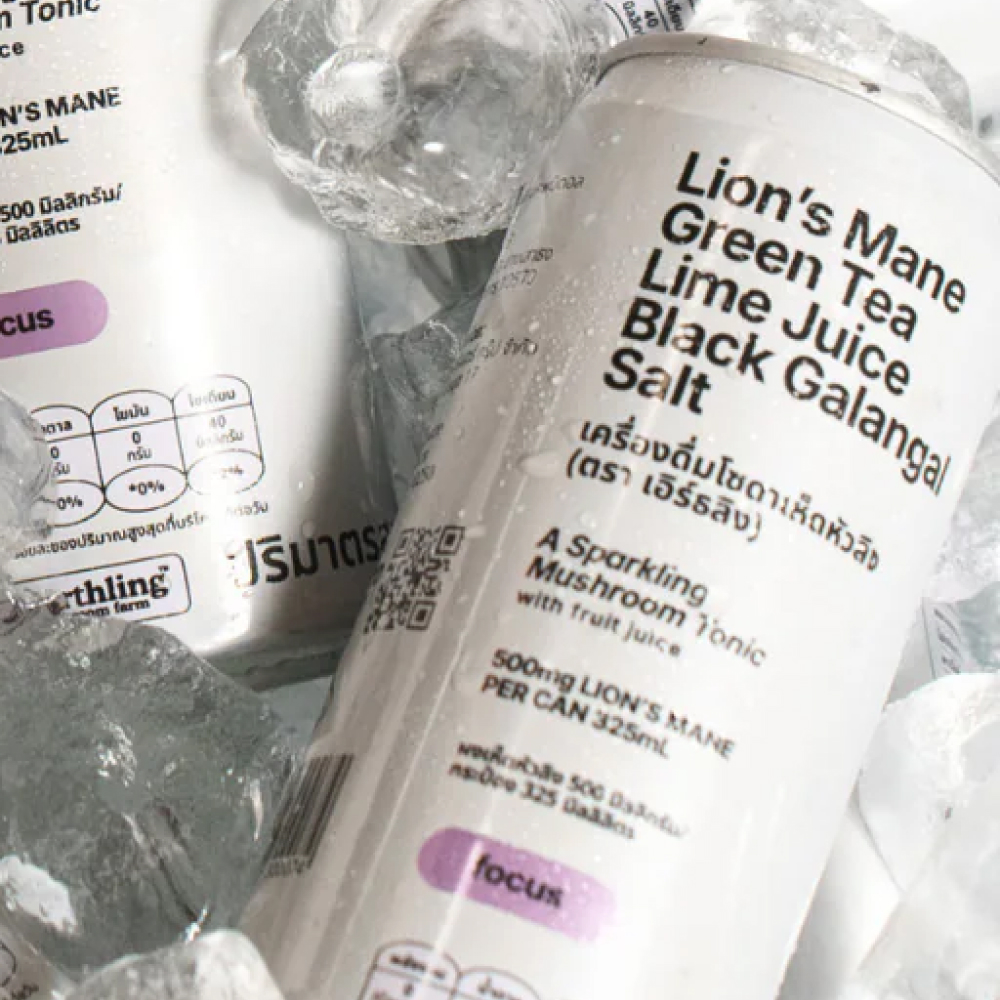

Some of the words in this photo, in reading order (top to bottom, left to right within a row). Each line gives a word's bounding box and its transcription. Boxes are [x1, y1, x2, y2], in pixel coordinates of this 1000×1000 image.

[45, 86, 123, 119] MANE
[0, 199, 34, 224] 500
[676, 151, 834, 237] Lion's
[842, 209, 967, 314] Mane
[661, 201, 823, 290] Green
[840, 259, 918, 342] Tea
[639, 248, 773, 324] Lime
[782, 302, 912, 396] Juice
[603, 346, 712, 415] Salt
[620, 298, 773, 383] Black
[784, 355, 952, 496] Galangal
[56, 496, 83, 510] 0%
[565, 446, 632, 487] (ตรา
[579, 416, 880, 573] เครื่องดื่มโซดาเห็ดหัวลิง
[535, 527, 561, 551] A
[565, 533, 709, 608] Sparkling
[114, 599, 150, 614] farm
[516, 588, 563, 616] with
[569, 599, 621, 634] fruit
[622, 617, 682, 659] juice
[525, 556, 687, 628] Mushroom
[697, 611, 768, 668] Tonic
[481, 675, 529, 704] PER
[533, 688, 588, 725] CAN
[592, 709, 671, 760] 325mL
[491, 648, 576, 692] 500mg
[578, 675, 661, 724] LION'S
[665, 710, 737, 761] MANE
[521, 781, 557, 808] 325
[473, 853, 564, 909] focus
